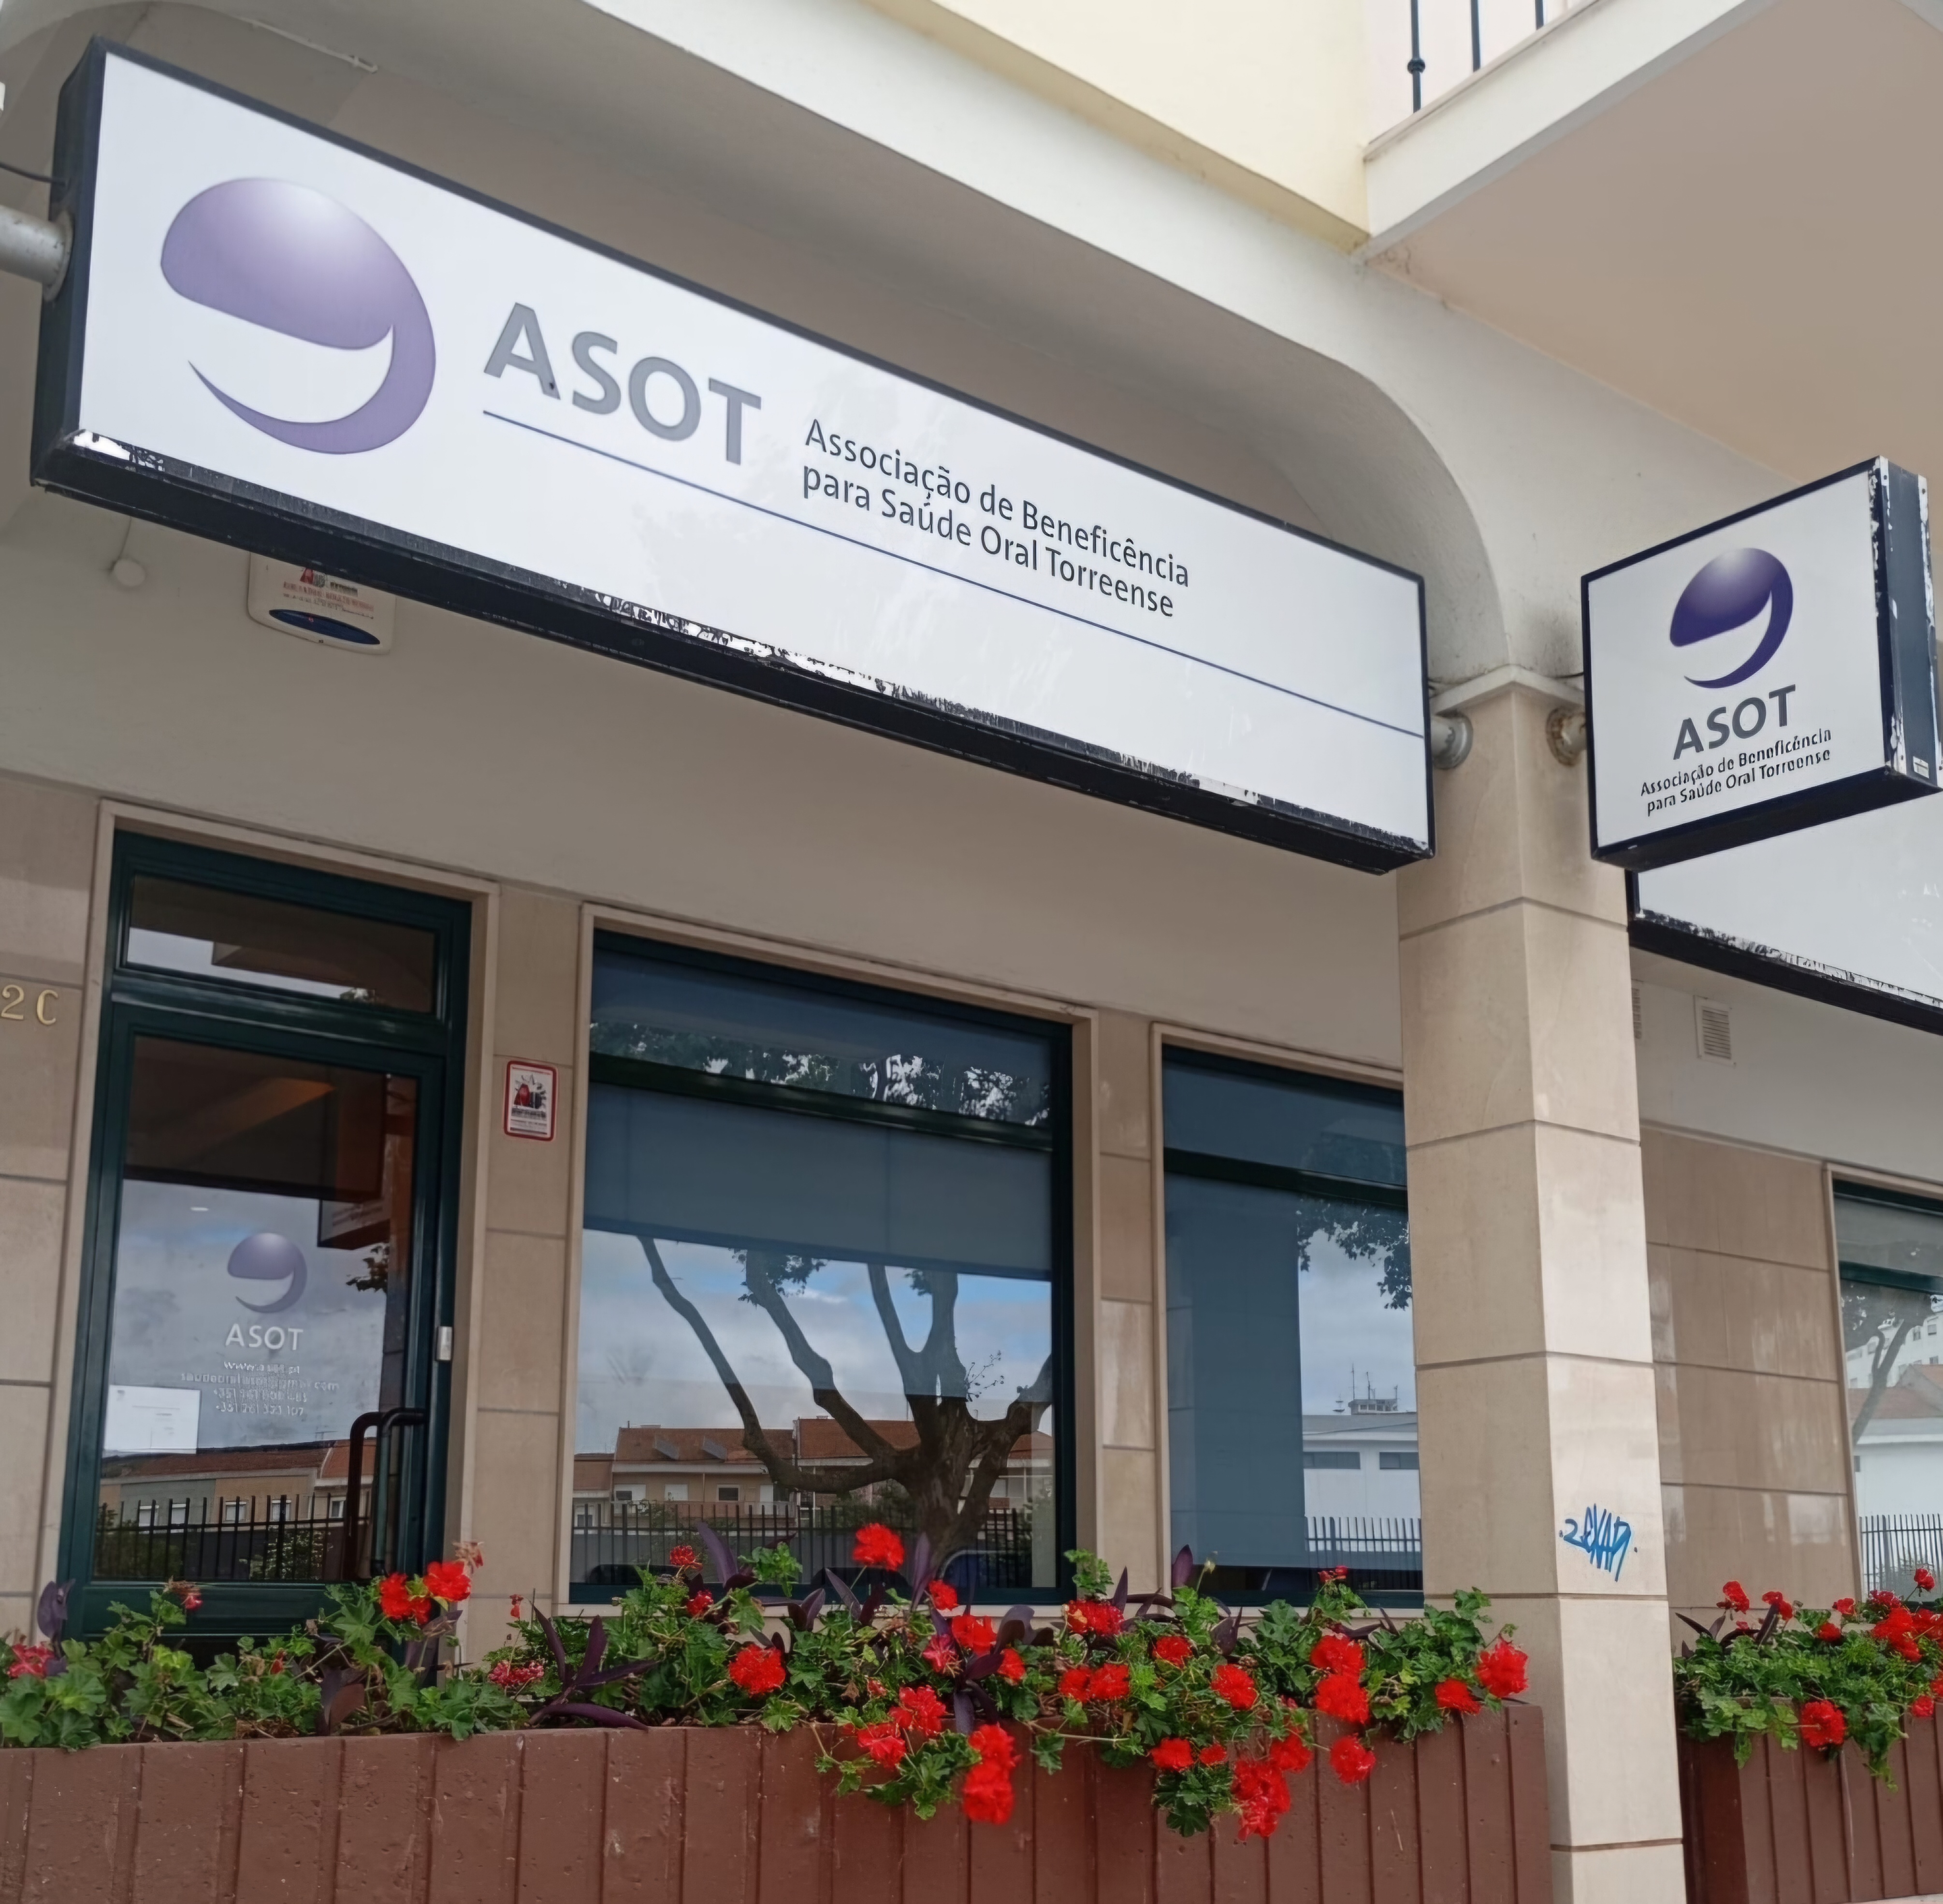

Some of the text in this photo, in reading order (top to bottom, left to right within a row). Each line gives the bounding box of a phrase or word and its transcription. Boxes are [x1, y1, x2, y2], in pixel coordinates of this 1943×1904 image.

[483, 302, 762, 466] ASOT
[804, 465, 1174, 617] para Saúde Oral Torreense
[805, 418, 1189, 588] Associação de Beneficência
[1673, 684, 1796, 760] ASOT
[1640, 728, 1831, 797] Associação de Beneficência
[1648, 750, 1830, 817] para Saúde Oral Torreense
[225, 1323, 304, 1351] ASOT
